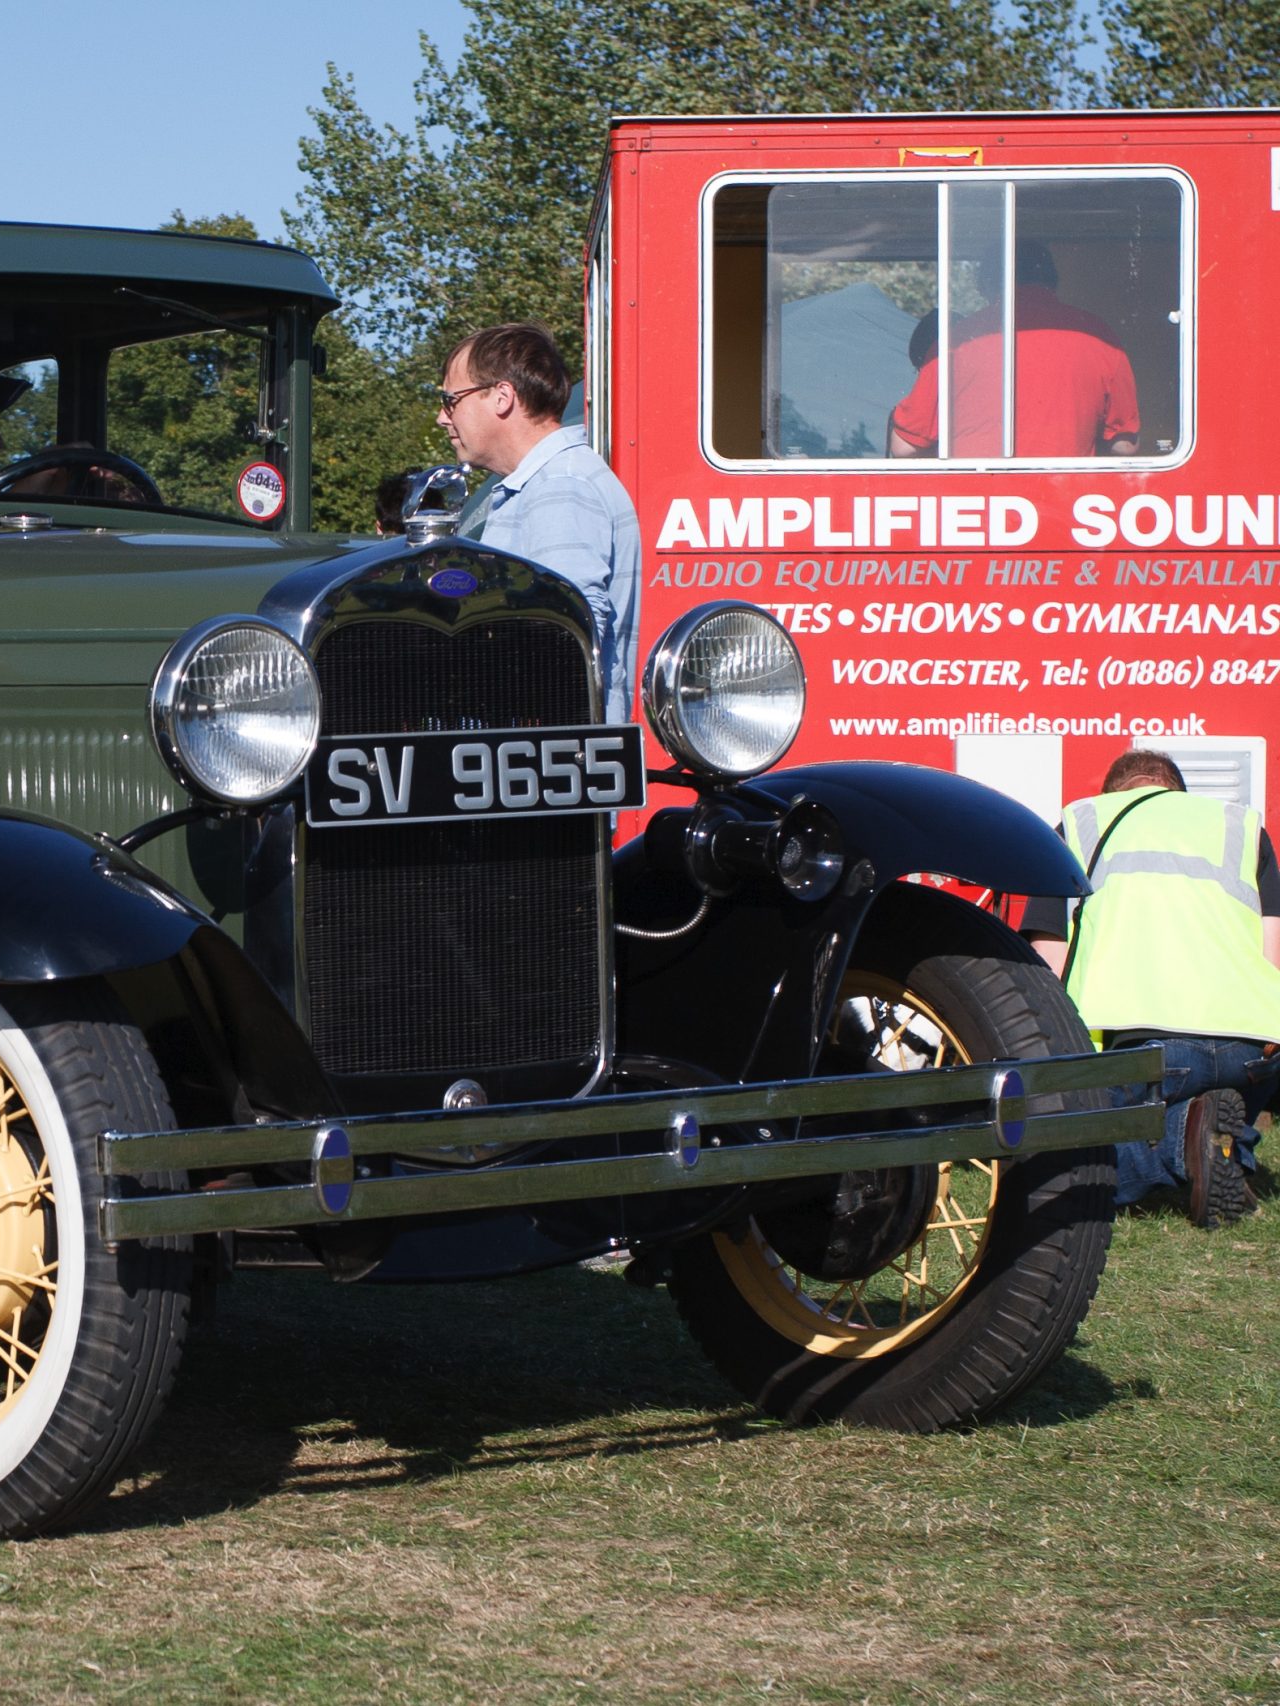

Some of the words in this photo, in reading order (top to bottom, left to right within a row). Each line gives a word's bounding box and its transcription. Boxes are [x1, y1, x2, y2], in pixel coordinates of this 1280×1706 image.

[655, 495, 1039, 549] AMPLIFIED
[1070, 493, 1280, 548] SOUN
[436, 573, 472, 590] Ford
[649, 560, 763, 588] AUDIO
[774, 559, 973, 592] EQUIPMENT
[984, 559, 1064, 586] HIRE
[1074, 559, 1101, 586] &
[1113, 559, 1280, 586] INSTALLAT
[860, 601, 1004, 634] SHOWS
[1031, 601, 1280, 636] GYMKHANAS
[832, 658, 1030, 693] WORCESTER,
[1041, 658, 1089, 686] Tel:
[1097, 655, 1205, 690] (01886)
[1209, 658, 1280, 686] 8847
[829, 712, 1208, 737] www.amplifiedsound.co.uk
[328, 745, 415, 817] SV
[452, 736, 626, 810] 9655
